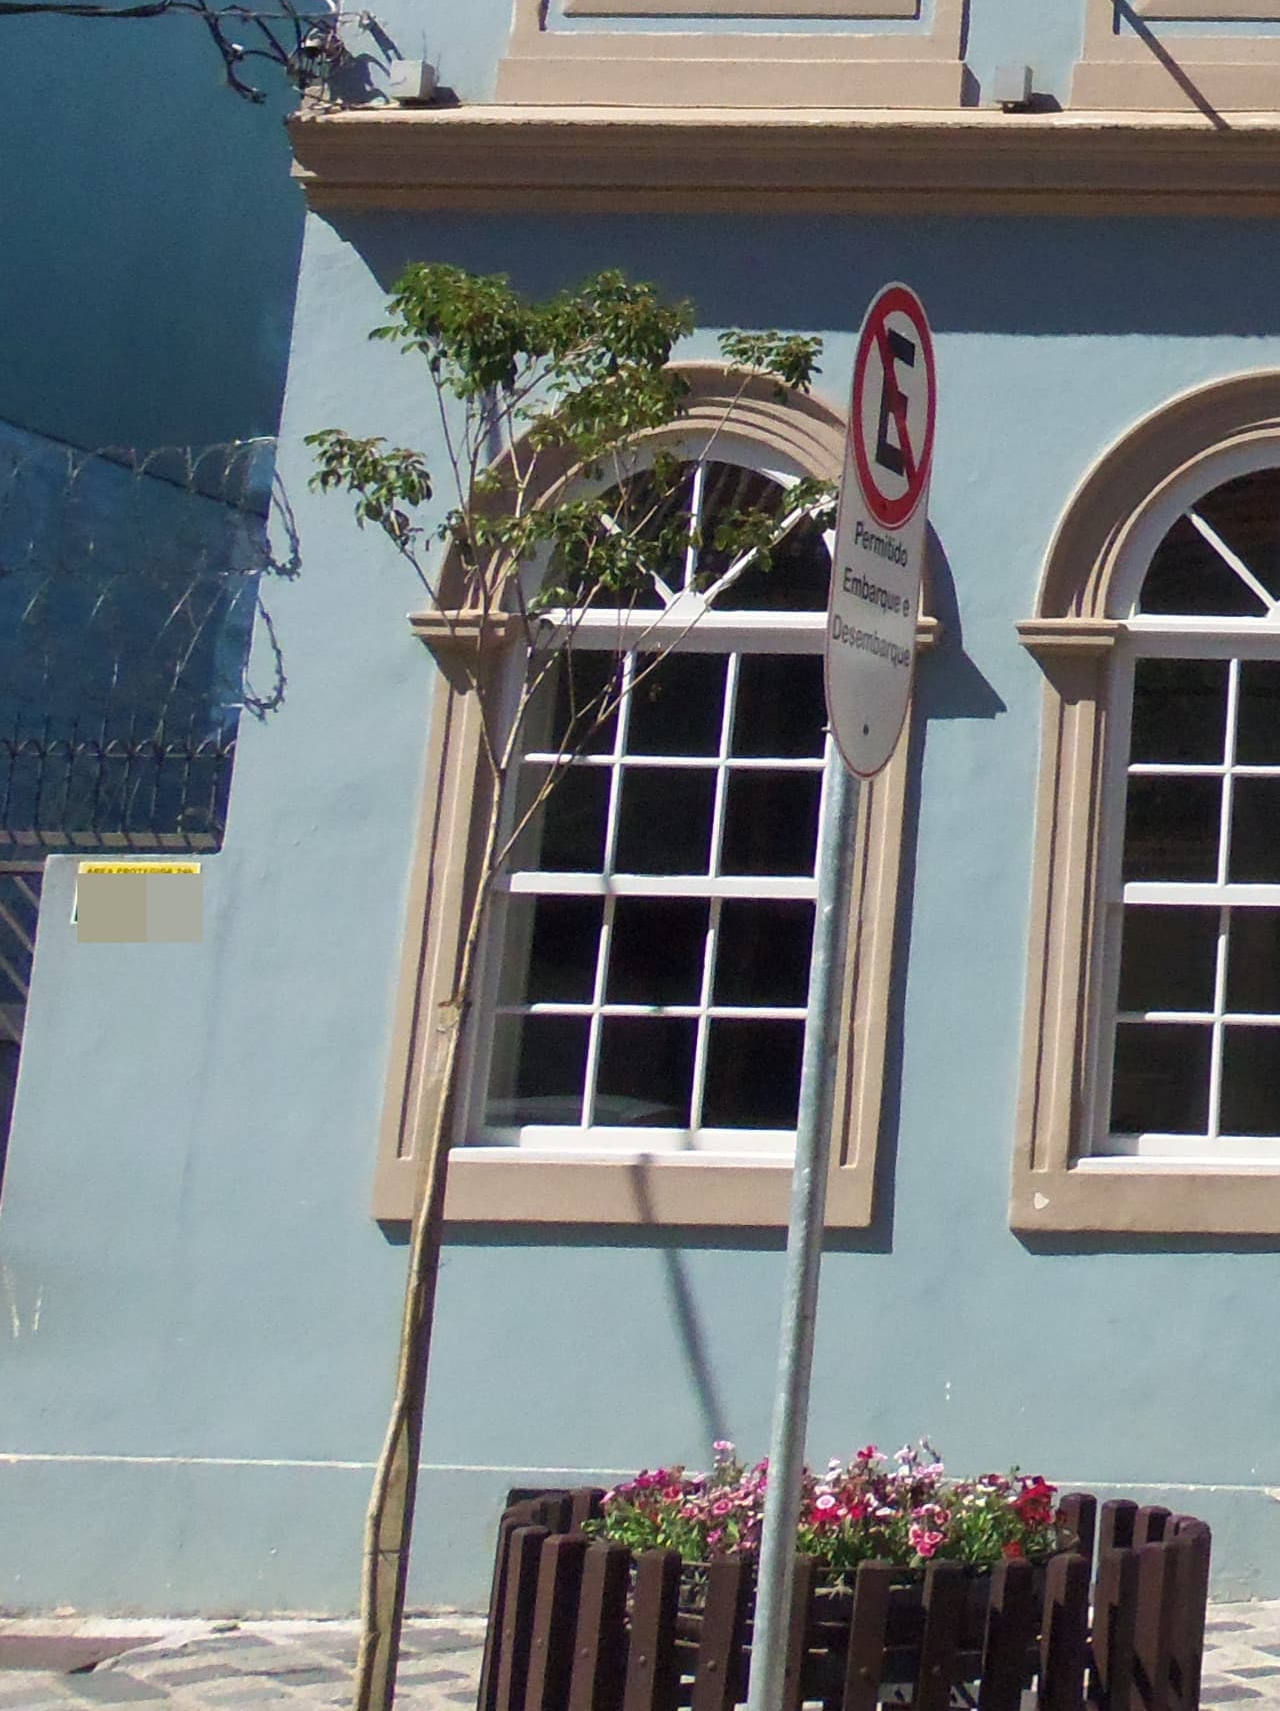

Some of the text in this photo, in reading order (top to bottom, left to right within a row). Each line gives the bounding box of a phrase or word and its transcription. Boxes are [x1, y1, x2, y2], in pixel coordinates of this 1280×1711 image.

[854, 521, 907, 567] Permitido
[842, 568, 910, 617] Embarque e
[832, 614, 911, 668] Desembarque
